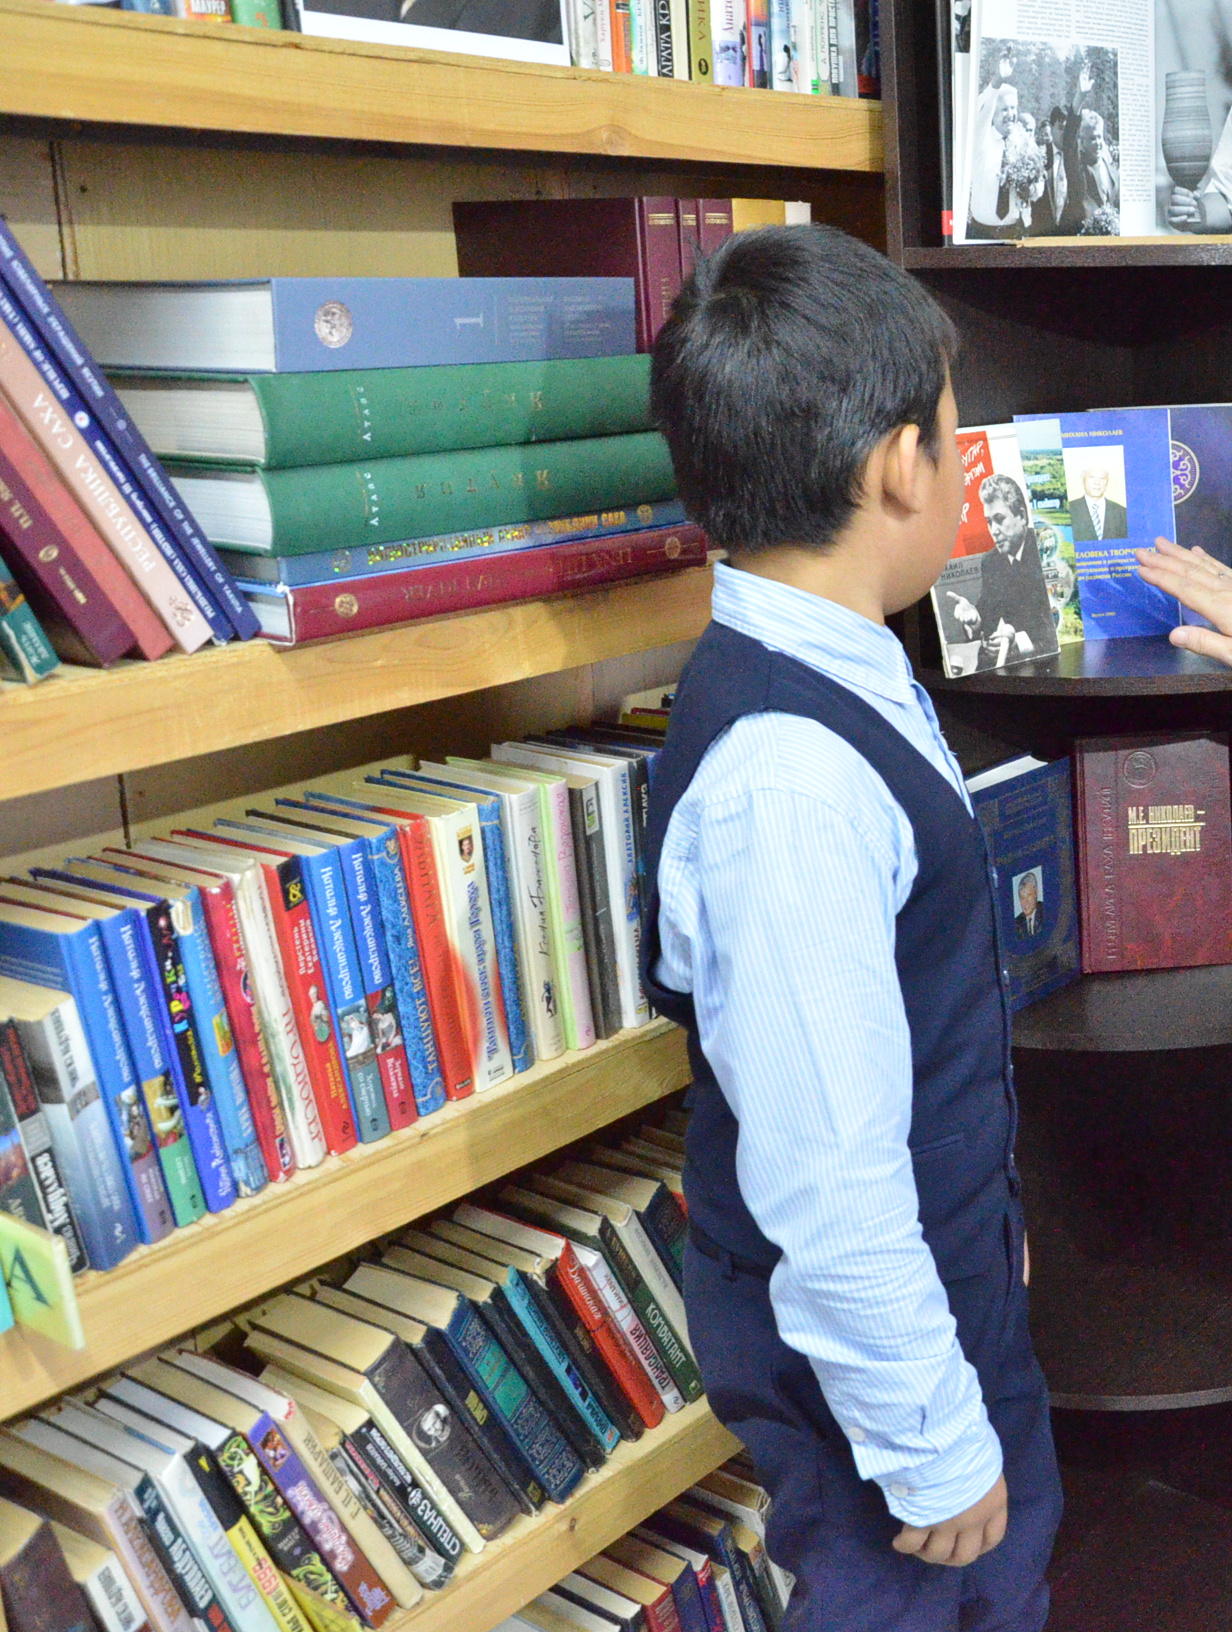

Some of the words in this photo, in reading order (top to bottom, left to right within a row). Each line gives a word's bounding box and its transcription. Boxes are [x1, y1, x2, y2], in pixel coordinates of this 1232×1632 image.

[596, 9, 606, 42] Харуки
[828, 28, 837, 44] ДЛЯ
[658, 30, 672, 75] АГАТА
[829, 46, 840, 83] ЛОВУШКА
[46, 313, 85, 366] УКРАШЕНИЙ
[28, 392, 76, 451] САХА
[1061, 430, 1087, 439] МИХАИЛ
[1089, 428, 1123, 437] НИКОЛАЕВ
[69, 453, 159, 573] РЕСПУБЛИКА
[190, 535, 218, 572] JEWELLERY
[939, 564, 979, 583] НИКОЛАЕВ
[619, 772, 630, 814] АЛЕКСИН
[1128, 806, 1146, 825] М.Е.
[1148, 803, 1195, 823] НИКОЛАЕВ
[623, 816, 634, 862] АНАТОЛИЙ
[1128, 825, 1201, 857] ПРЕЗИДЕНТ
[392, 865, 410, 926] АЛЕКСЕЕВА
[463, 880, 483, 926] Гороха
[289, 926, 308, 975] Перстень
[296, 919, 316, 974] Екатерины
[326, 917, 358, 999] Александрова
[356, 902, 388, 984] Александрова
[407, 957, 423, 993] ВСЕ!
[414, 996, 438, 1073] ТАНЦУЮТ
[274, 1005, 327, 1143] ПРОДЮСЕР
[28, 1151, 74, 1228] Абдуллаев
[627, 1322, 673, 1390] ТРАНСЛЯЦИЯ
[641, 1301, 688, 1367] КОМБАТАНТ
[414, 1496, 464, 1556] СПЕЦНАЗ
